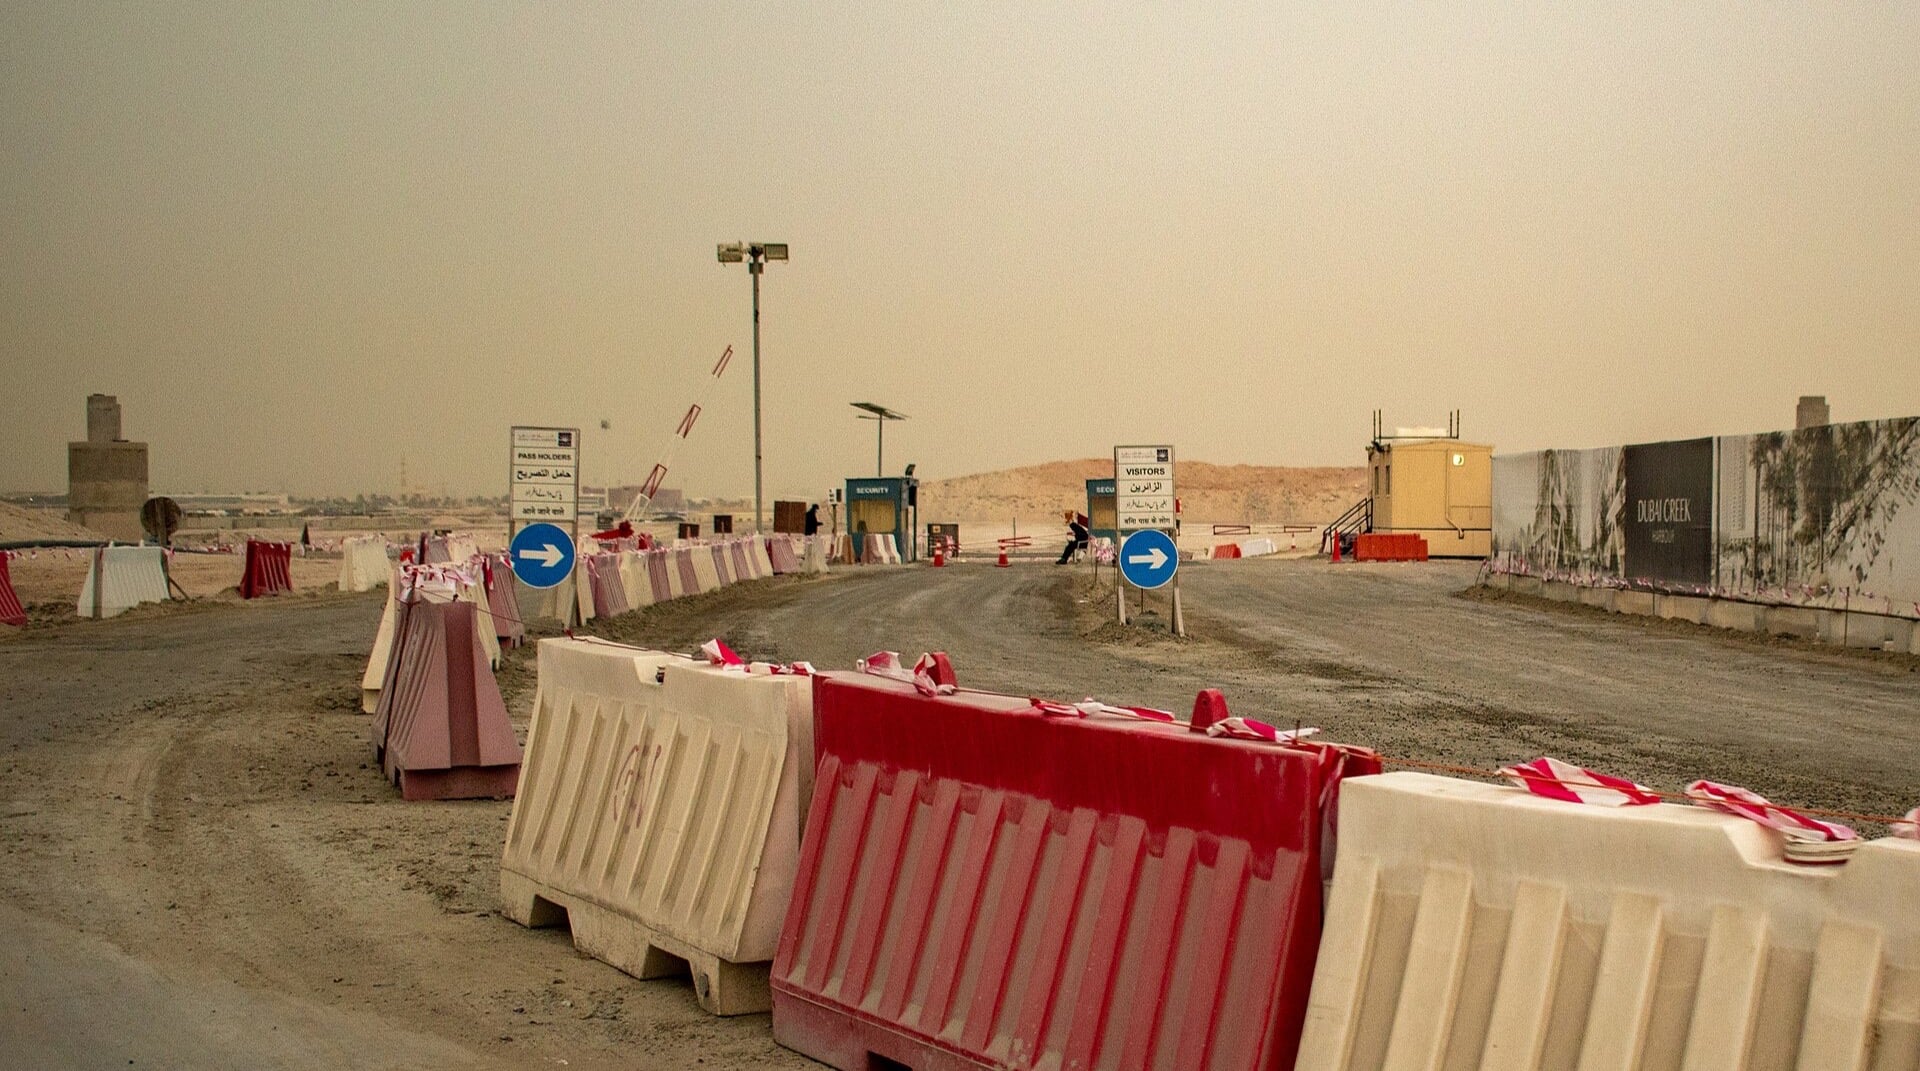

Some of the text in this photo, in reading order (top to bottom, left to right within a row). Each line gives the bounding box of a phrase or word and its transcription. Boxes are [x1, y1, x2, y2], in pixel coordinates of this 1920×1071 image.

[1126, 467, 1165, 476] VISITORS
[1637, 498, 1691, 522] DUBAI CREEK
